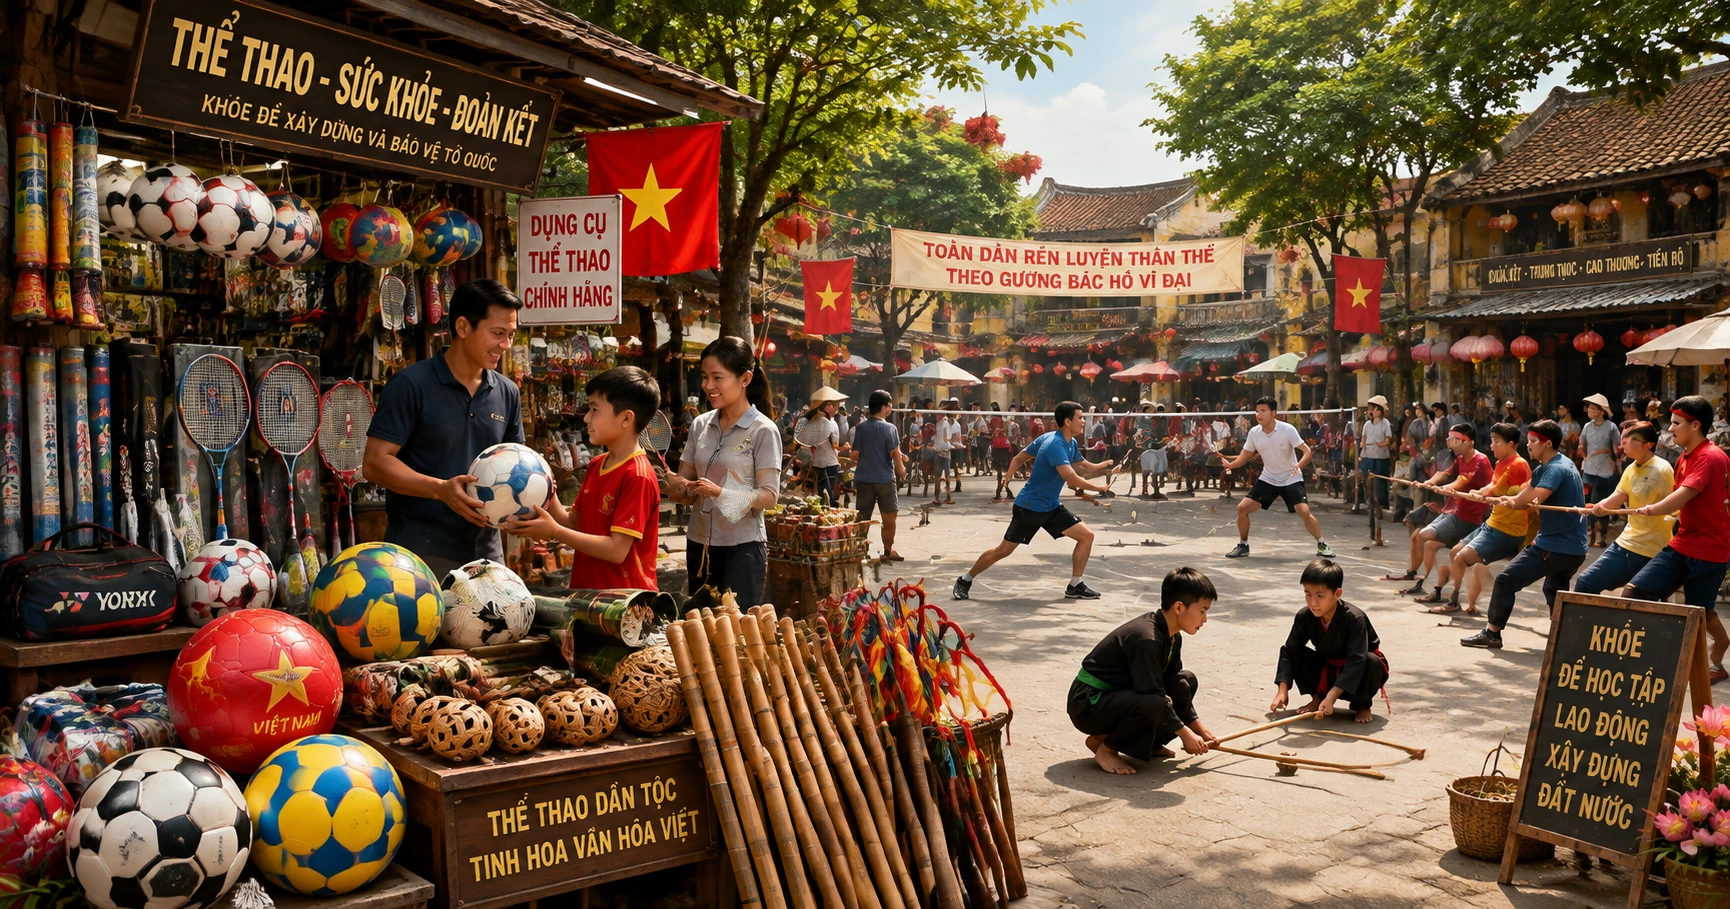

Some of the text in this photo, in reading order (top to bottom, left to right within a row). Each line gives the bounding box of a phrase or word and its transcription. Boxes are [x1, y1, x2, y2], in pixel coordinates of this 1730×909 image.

[171, 10, 240, 77] THỂ
[241, 36, 315, 96] THAO
[335, 56, 383, 112] SỨC
[384, 70, 442, 125] KHỎE
[531, 212, 606, 241] DỤNG CỤ
[528, 241, 610, 273] THỂ THAO
[1586, 259, 1603, 274] CAO
[524, 281, 567, 309] CHÍNH
[946, 268, 993, 286] THEO
[1162, 272, 1191, 291] ĐẠI
[1585, 667, 1624, 701] HỌC
[1554, 703, 1650, 746] LAO ĐỘNG
[535, 795, 589, 827] THAO
[640, 775, 677, 810] TỘC
[1578, 793, 1634, 830] NƯỚC
[469, 848, 520, 883] TINH
[526, 839, 569, 871] HOA
